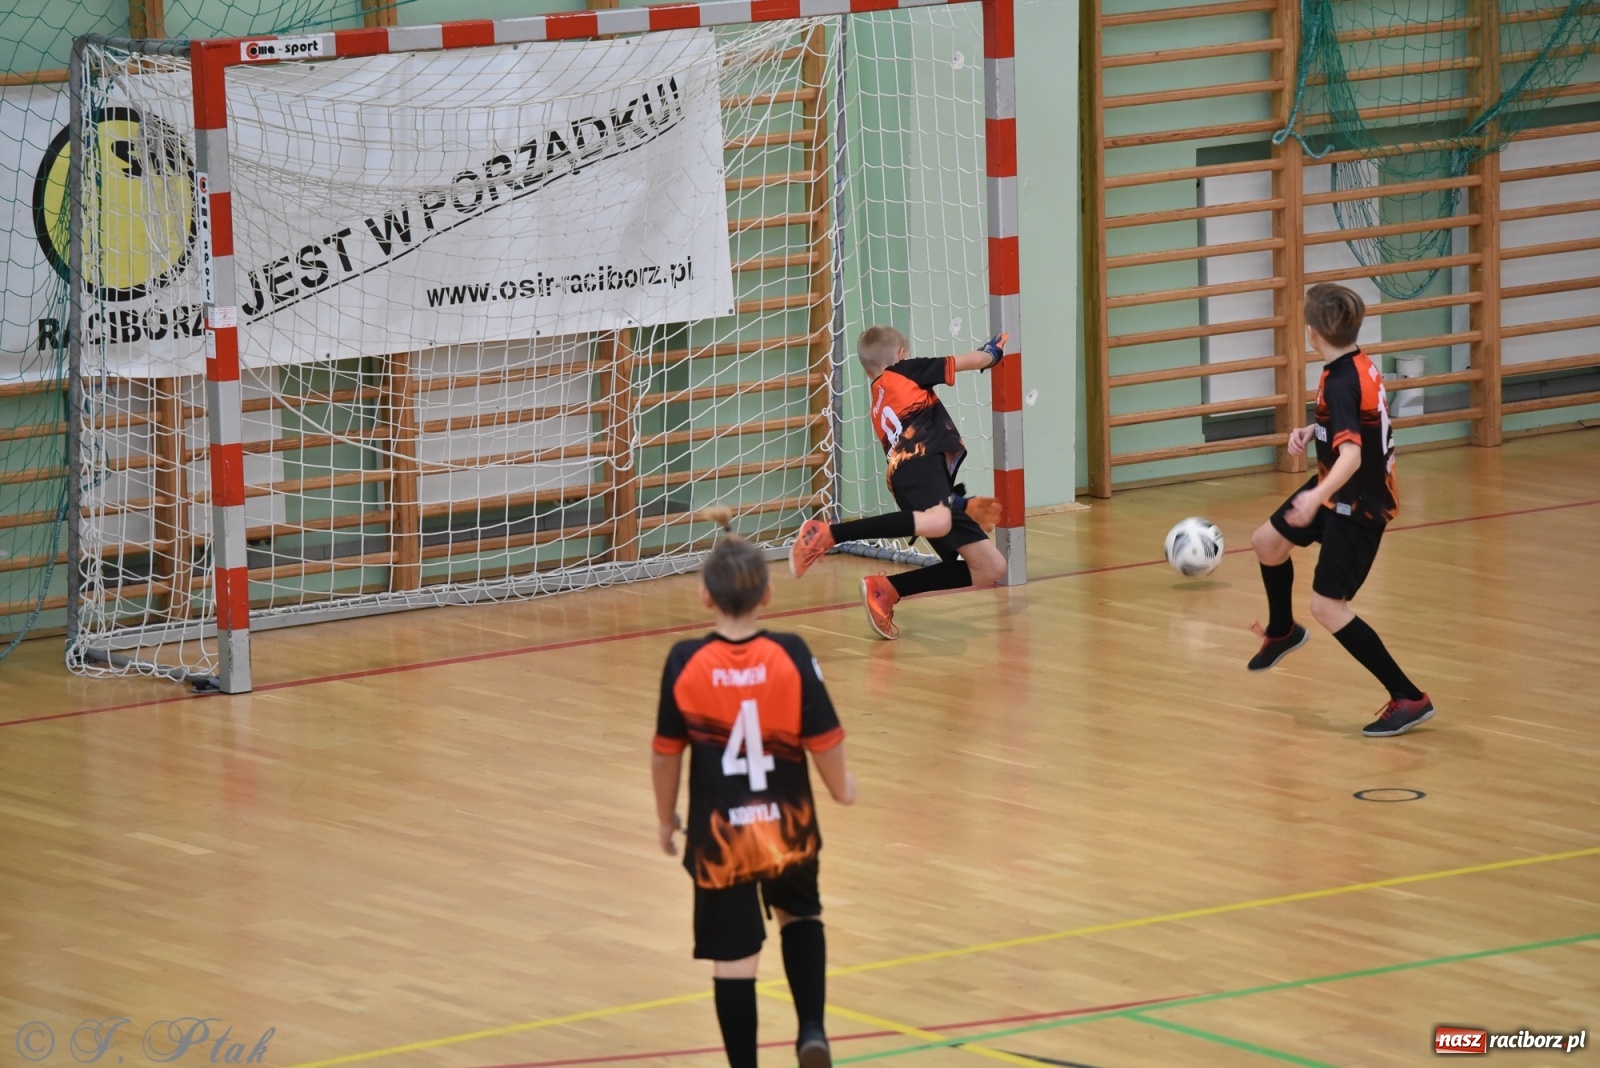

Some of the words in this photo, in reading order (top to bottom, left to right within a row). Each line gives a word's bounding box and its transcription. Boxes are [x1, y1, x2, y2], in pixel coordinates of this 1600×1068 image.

[285, 40, 318, 55] sport
[241, 227, 352, 316] JEST
[364, 202, 411, 256] W
[426, 256, 694, 307] www.osir-raciborz.pl
[721, 699, 774, 792] 4
